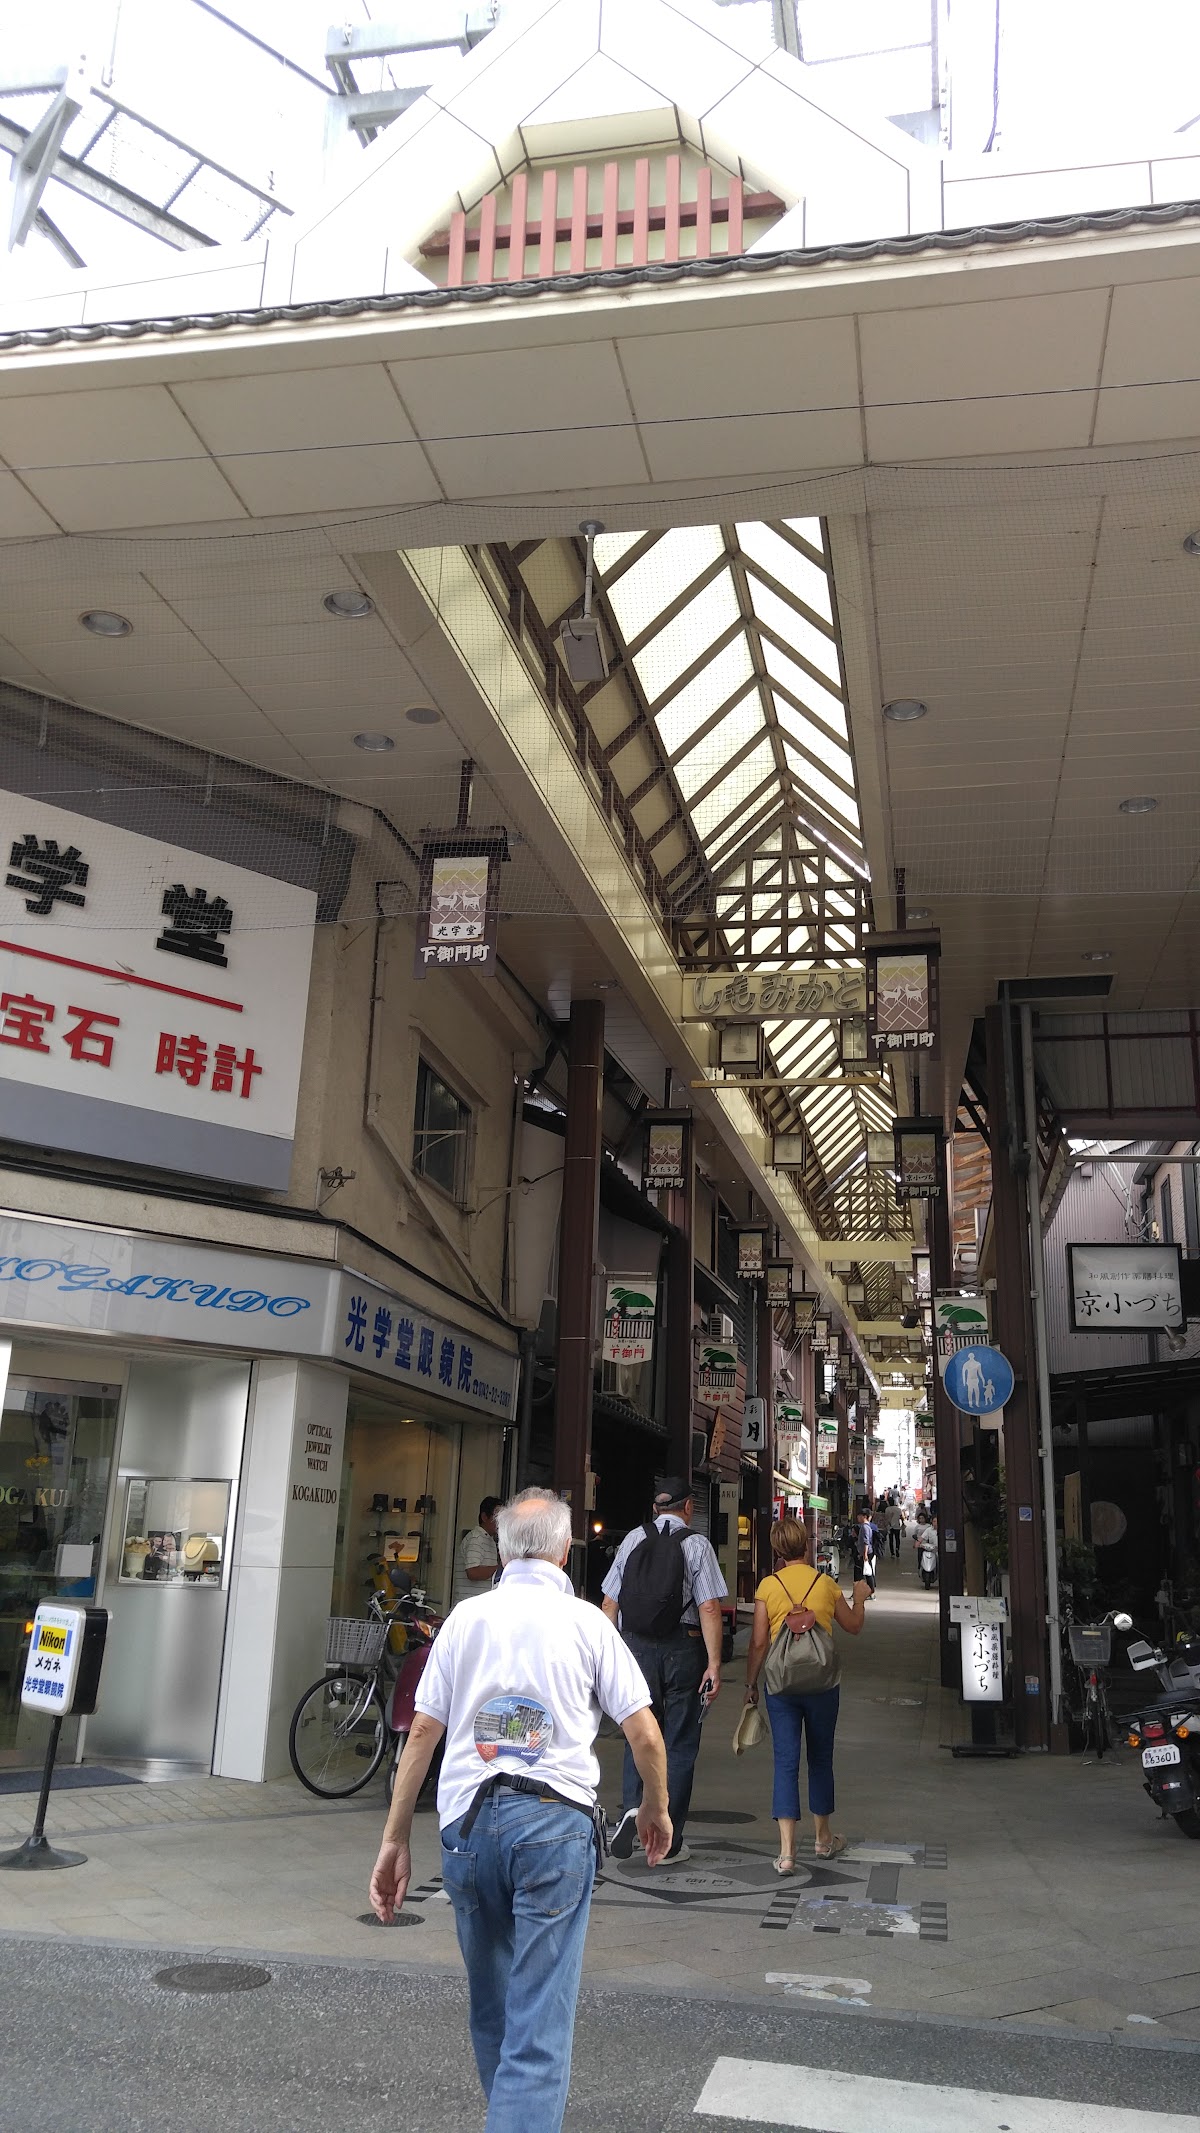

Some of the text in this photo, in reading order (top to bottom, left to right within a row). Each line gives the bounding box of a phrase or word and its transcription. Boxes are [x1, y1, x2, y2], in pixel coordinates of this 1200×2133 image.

[437, 925, 477, 936] 光学堂
[420, 944, 490, 963] 下御門町
[0, 993, 264, 1098] 宝石 時計
[871, 1031, 935, 1049] 下御門町
[644, 1177, 685, 1188] 下御門町
[898, 1186, 941, 1197] 下御門町
[736, 1270, 765, 1279] 下御門町
[1076, 1290, 1181, 1316] 京小づち
[345, 1295, 473, 1393] 光学堂眼鏡院
[610, 1348, 645, 1359] 下御門
[703, 1393, 730, 1402] 下御門
[307, 1423, 333, 1439] OPTICAL
[747, 1421, 760, 1442] 月
[304, 1440, 332, 1455] JEWELRY
[307, 1457, 328, 1471] WATCH
[292, 1484, 337, 1504] KOGAKUDO
[39, 1630, 66, 1650] Nikon
[35, 1656, 61, 1673] メガネ
[971, 1621, 990, 1692] 京小づち
[24, 1676, 65, 1698] 光学堂眼鏡院
[1150, 1751, 1177, 1765] 63601
